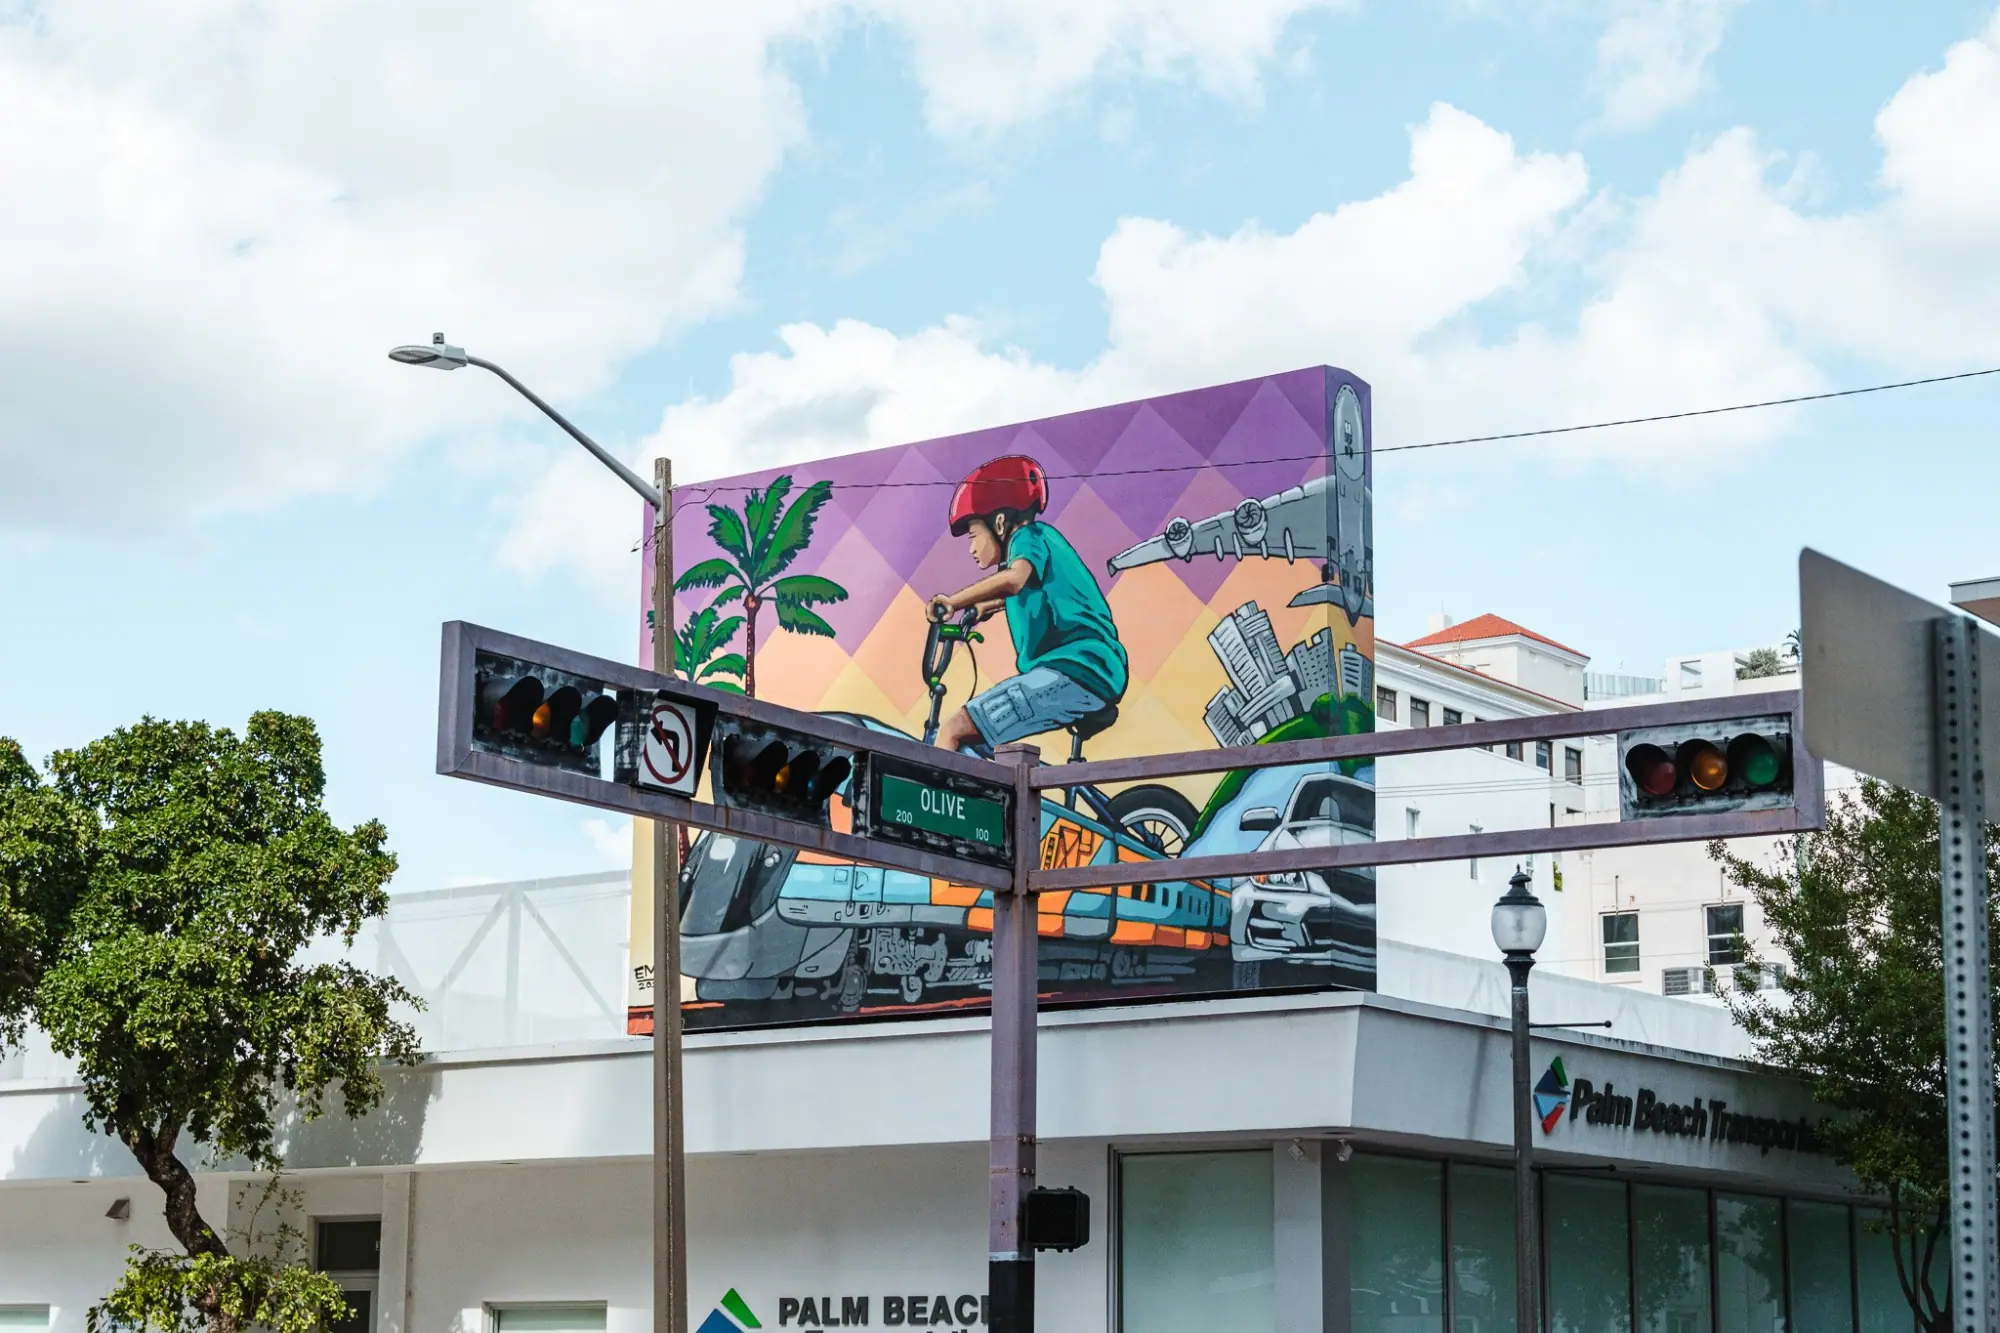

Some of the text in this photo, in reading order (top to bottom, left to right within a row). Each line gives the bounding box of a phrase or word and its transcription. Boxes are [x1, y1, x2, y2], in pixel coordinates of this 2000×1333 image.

[895, 809, 913, 824] 200
[920, 788, 966, 820] OLIVE
[975, 827, 989, 842] 100
[1569, 1078, 1633, 1128] Palm
[1634, 1087, 1708, 1139] Beach
[778, 1296, 869, 1326] PALM
